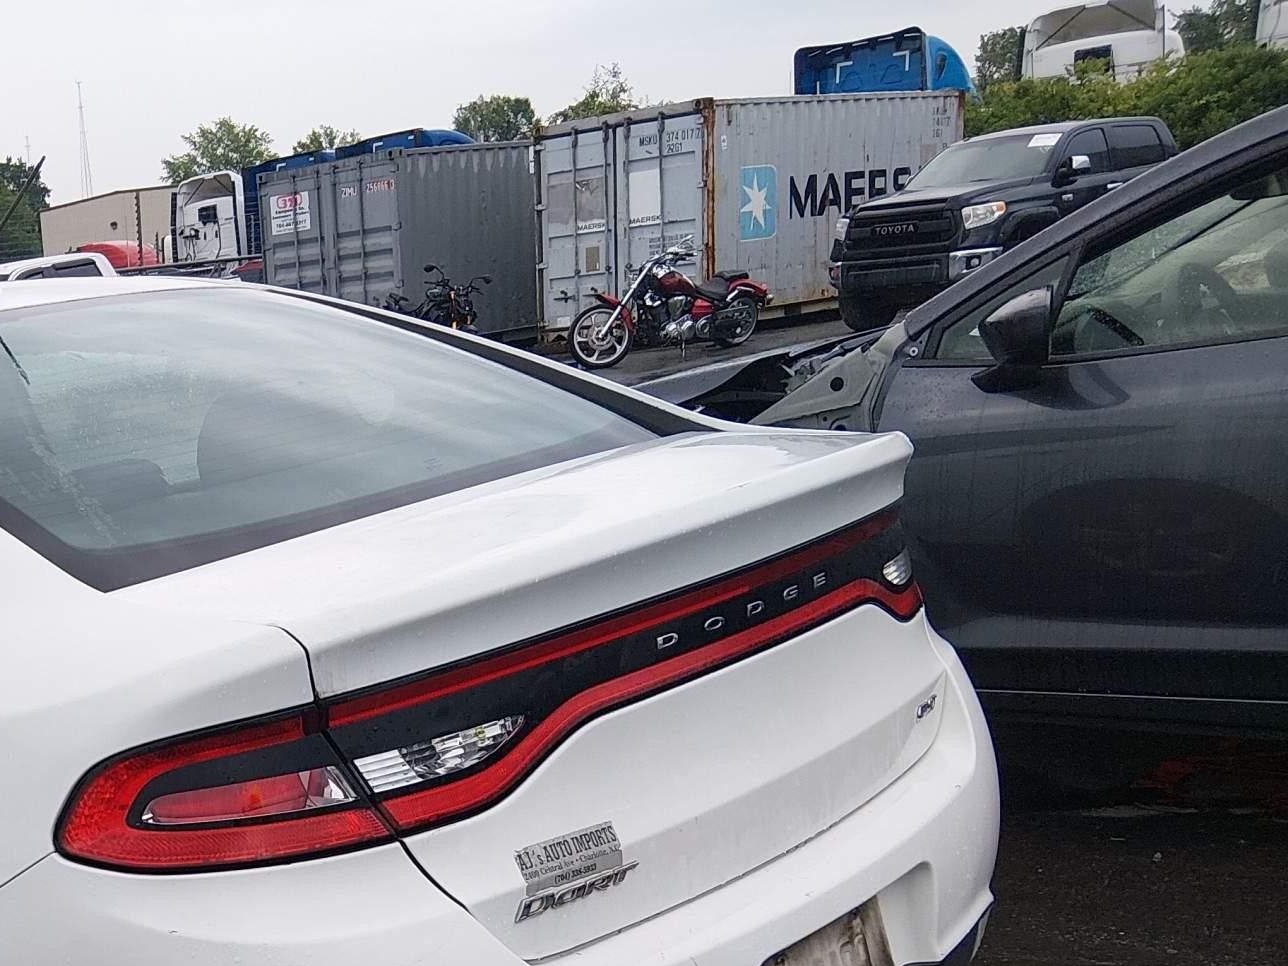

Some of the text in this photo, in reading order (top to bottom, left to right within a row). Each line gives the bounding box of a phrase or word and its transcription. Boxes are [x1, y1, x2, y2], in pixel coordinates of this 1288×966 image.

[790, 166, 921, 219] MAERS
[875, 224, 914, 235] TOYOTA
[656, 571, 827, 650] DODGE
[543, 840, 573, 863] AUTO
[571, 825, 617, 854] IMPORTS
